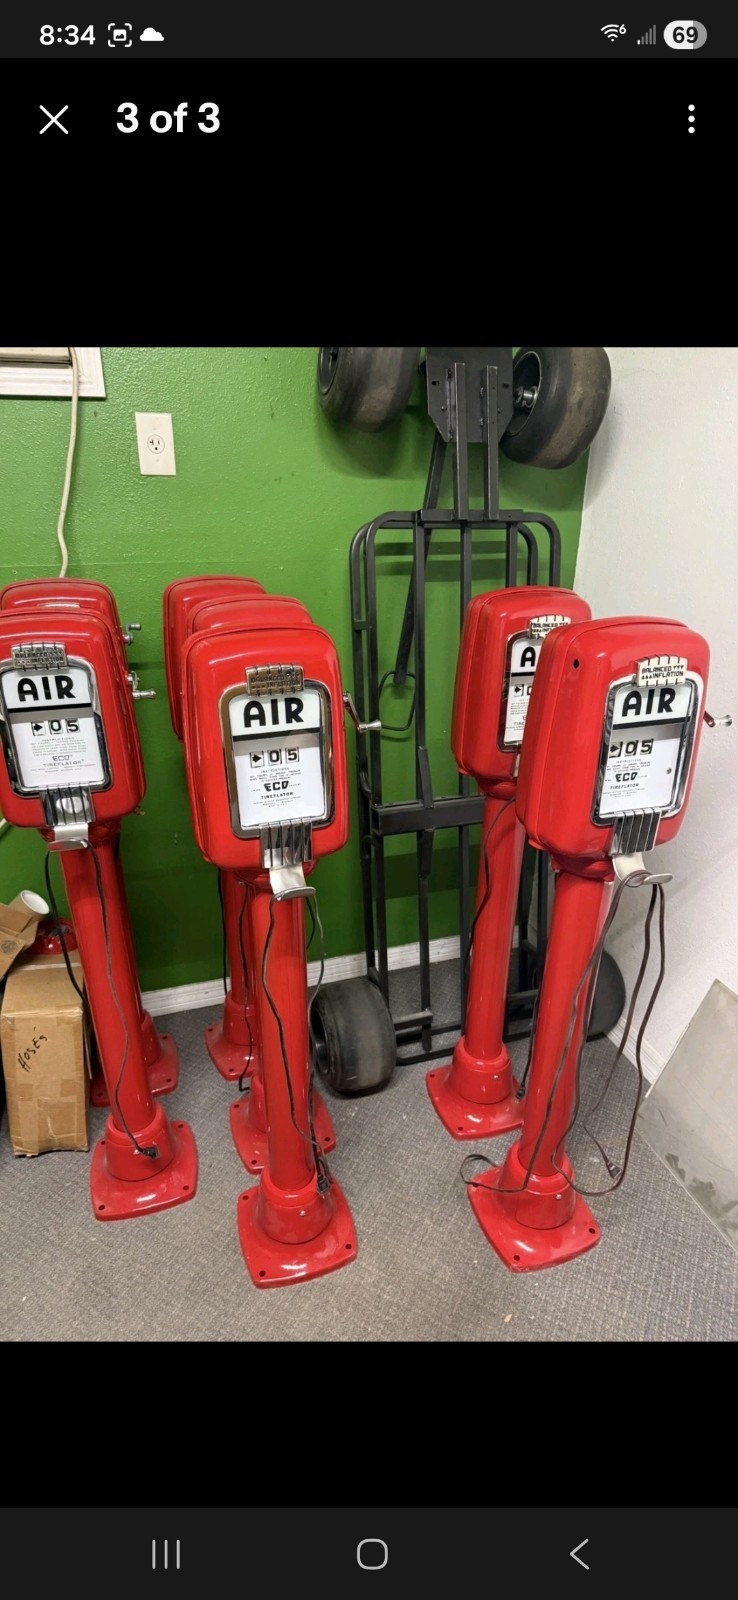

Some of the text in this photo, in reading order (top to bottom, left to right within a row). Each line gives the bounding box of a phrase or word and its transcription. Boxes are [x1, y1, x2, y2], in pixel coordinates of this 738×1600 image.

[641, 665, 672, 674] BALANCED
[17, 675, 76, 702] AIR
[622, 688, 676, 717] AIR
[243, 697, 305, 728] AIR
[615, 771, 638, 782] ECO
[263, 780, 290, 792] ECO
[260, 791, 294, 800] TIREFLATOR
